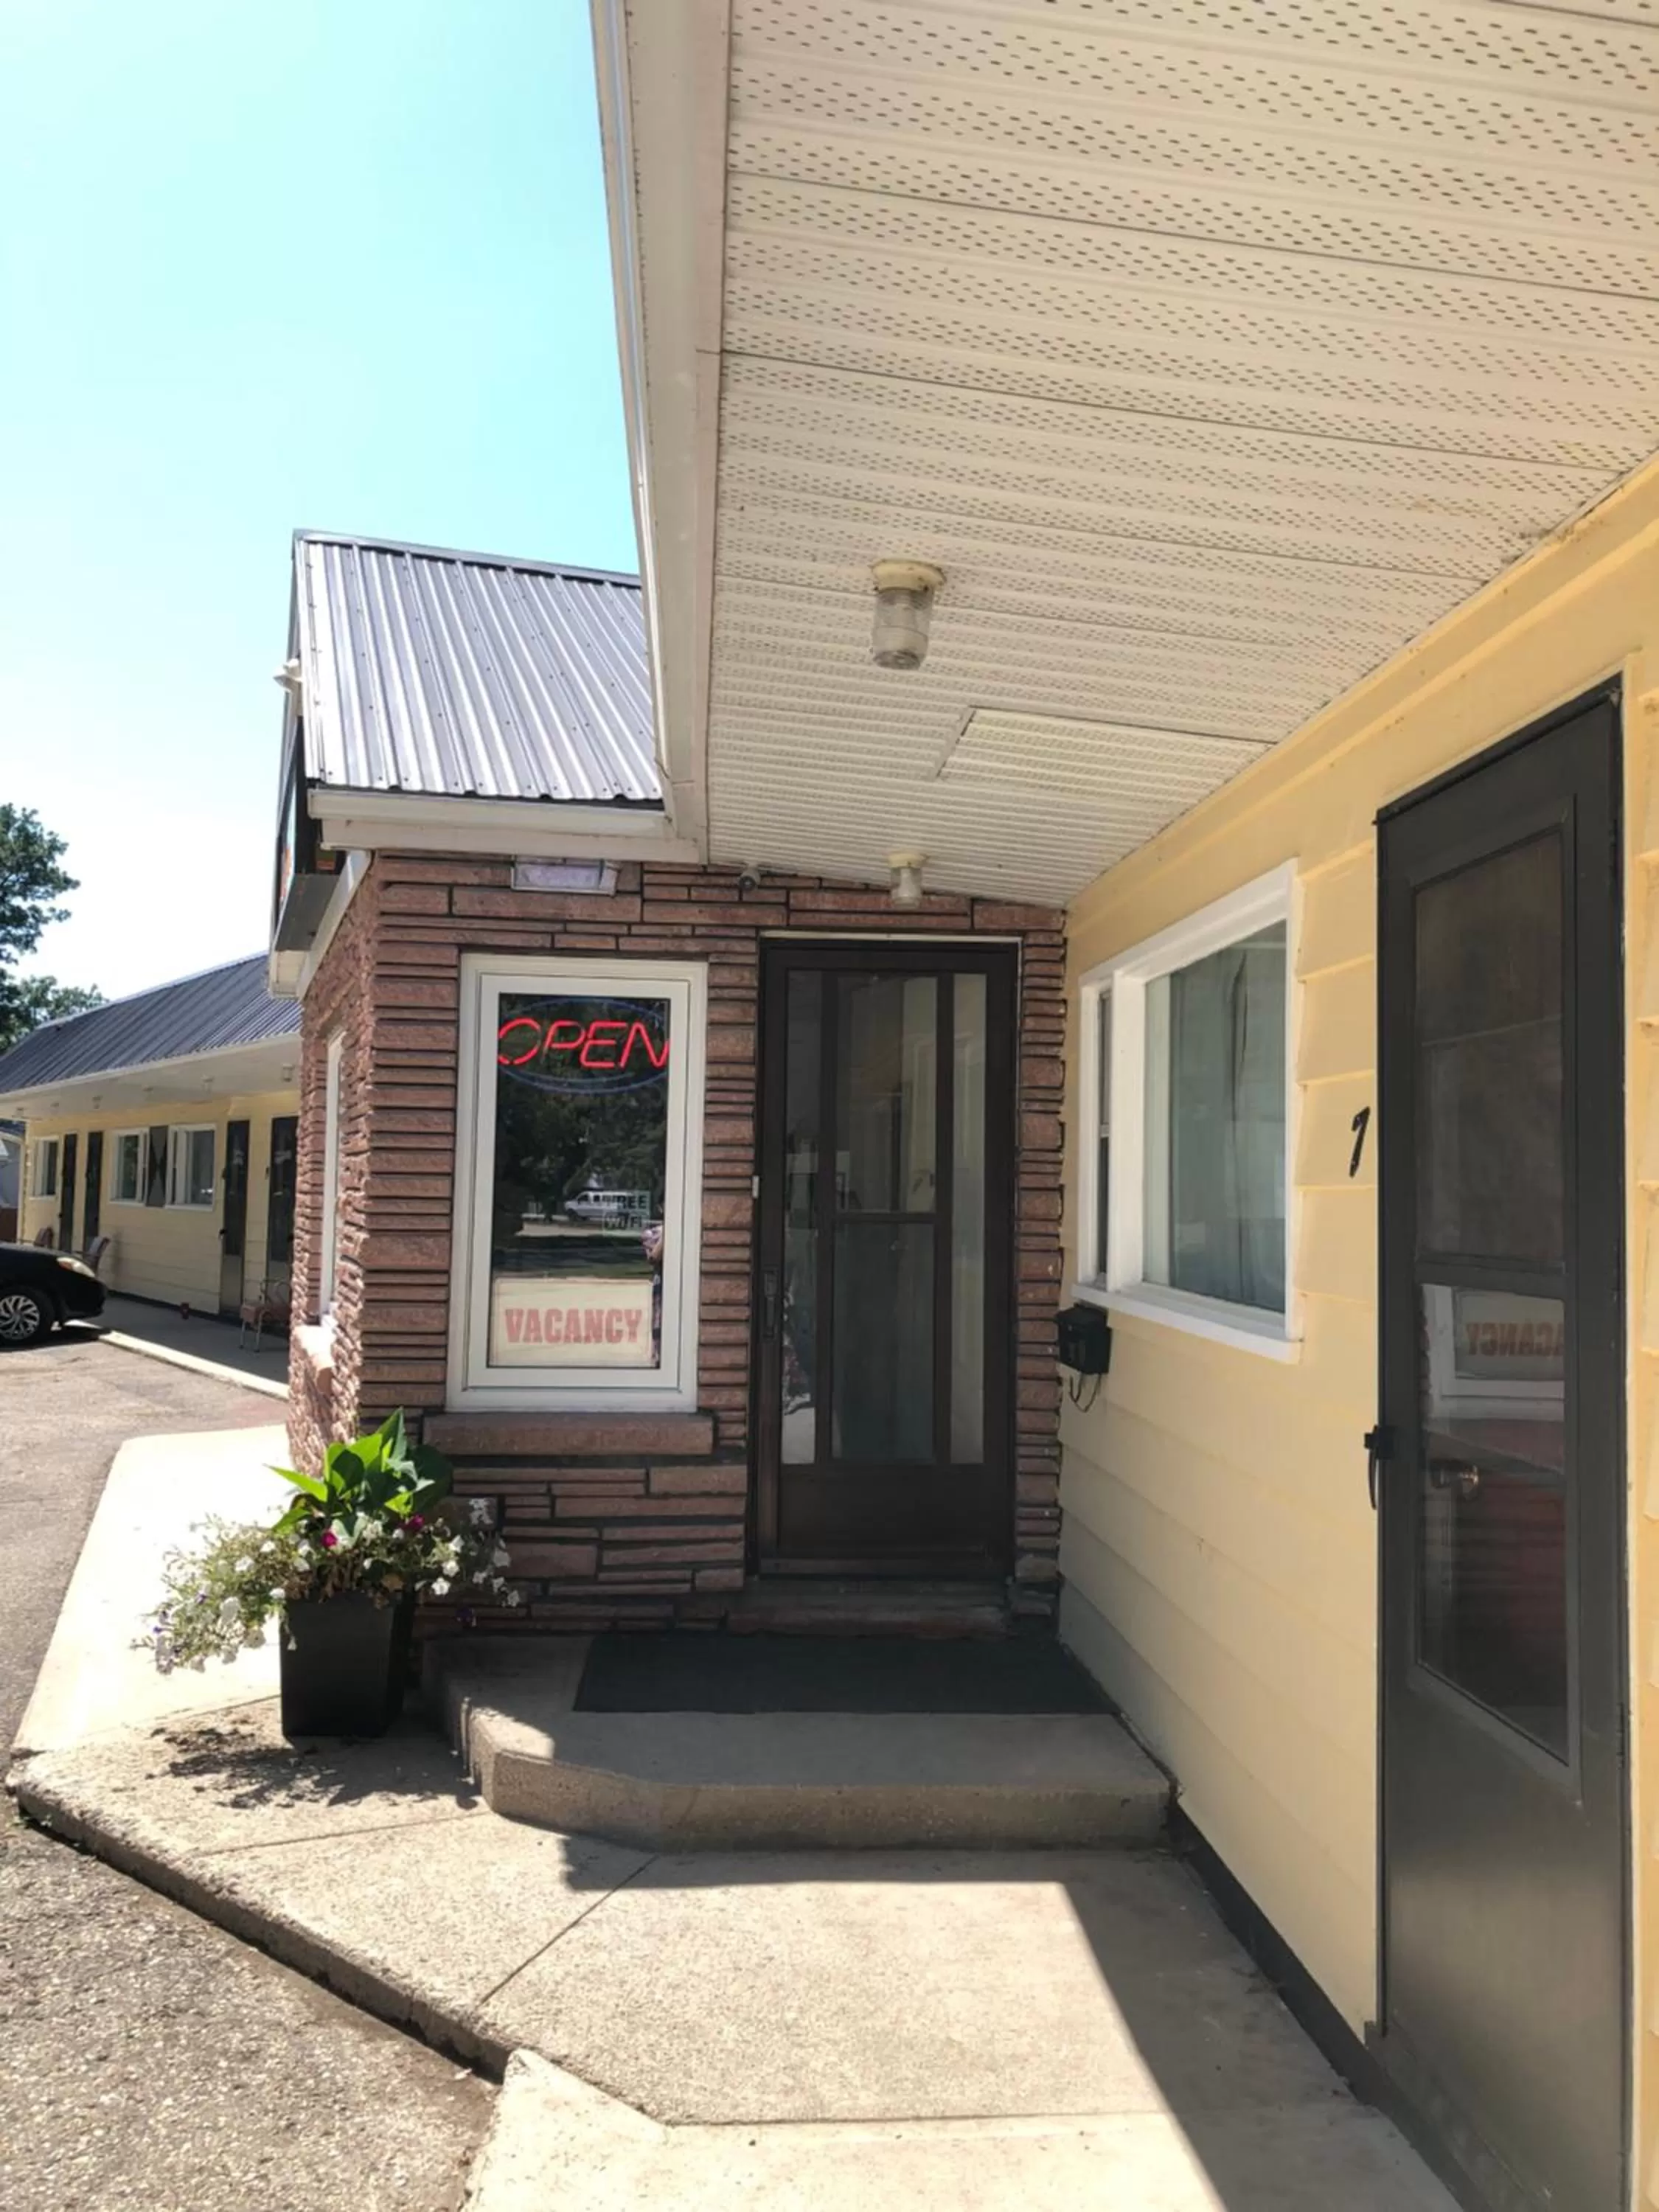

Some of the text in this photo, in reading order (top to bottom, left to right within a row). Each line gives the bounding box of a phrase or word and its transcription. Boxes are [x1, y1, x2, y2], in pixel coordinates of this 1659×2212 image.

[498, 1017, 669, 1068] OPEN
[1349, 1105, 1371, 1179] 1
[504, 1307, 643, 1344] VACANCY
